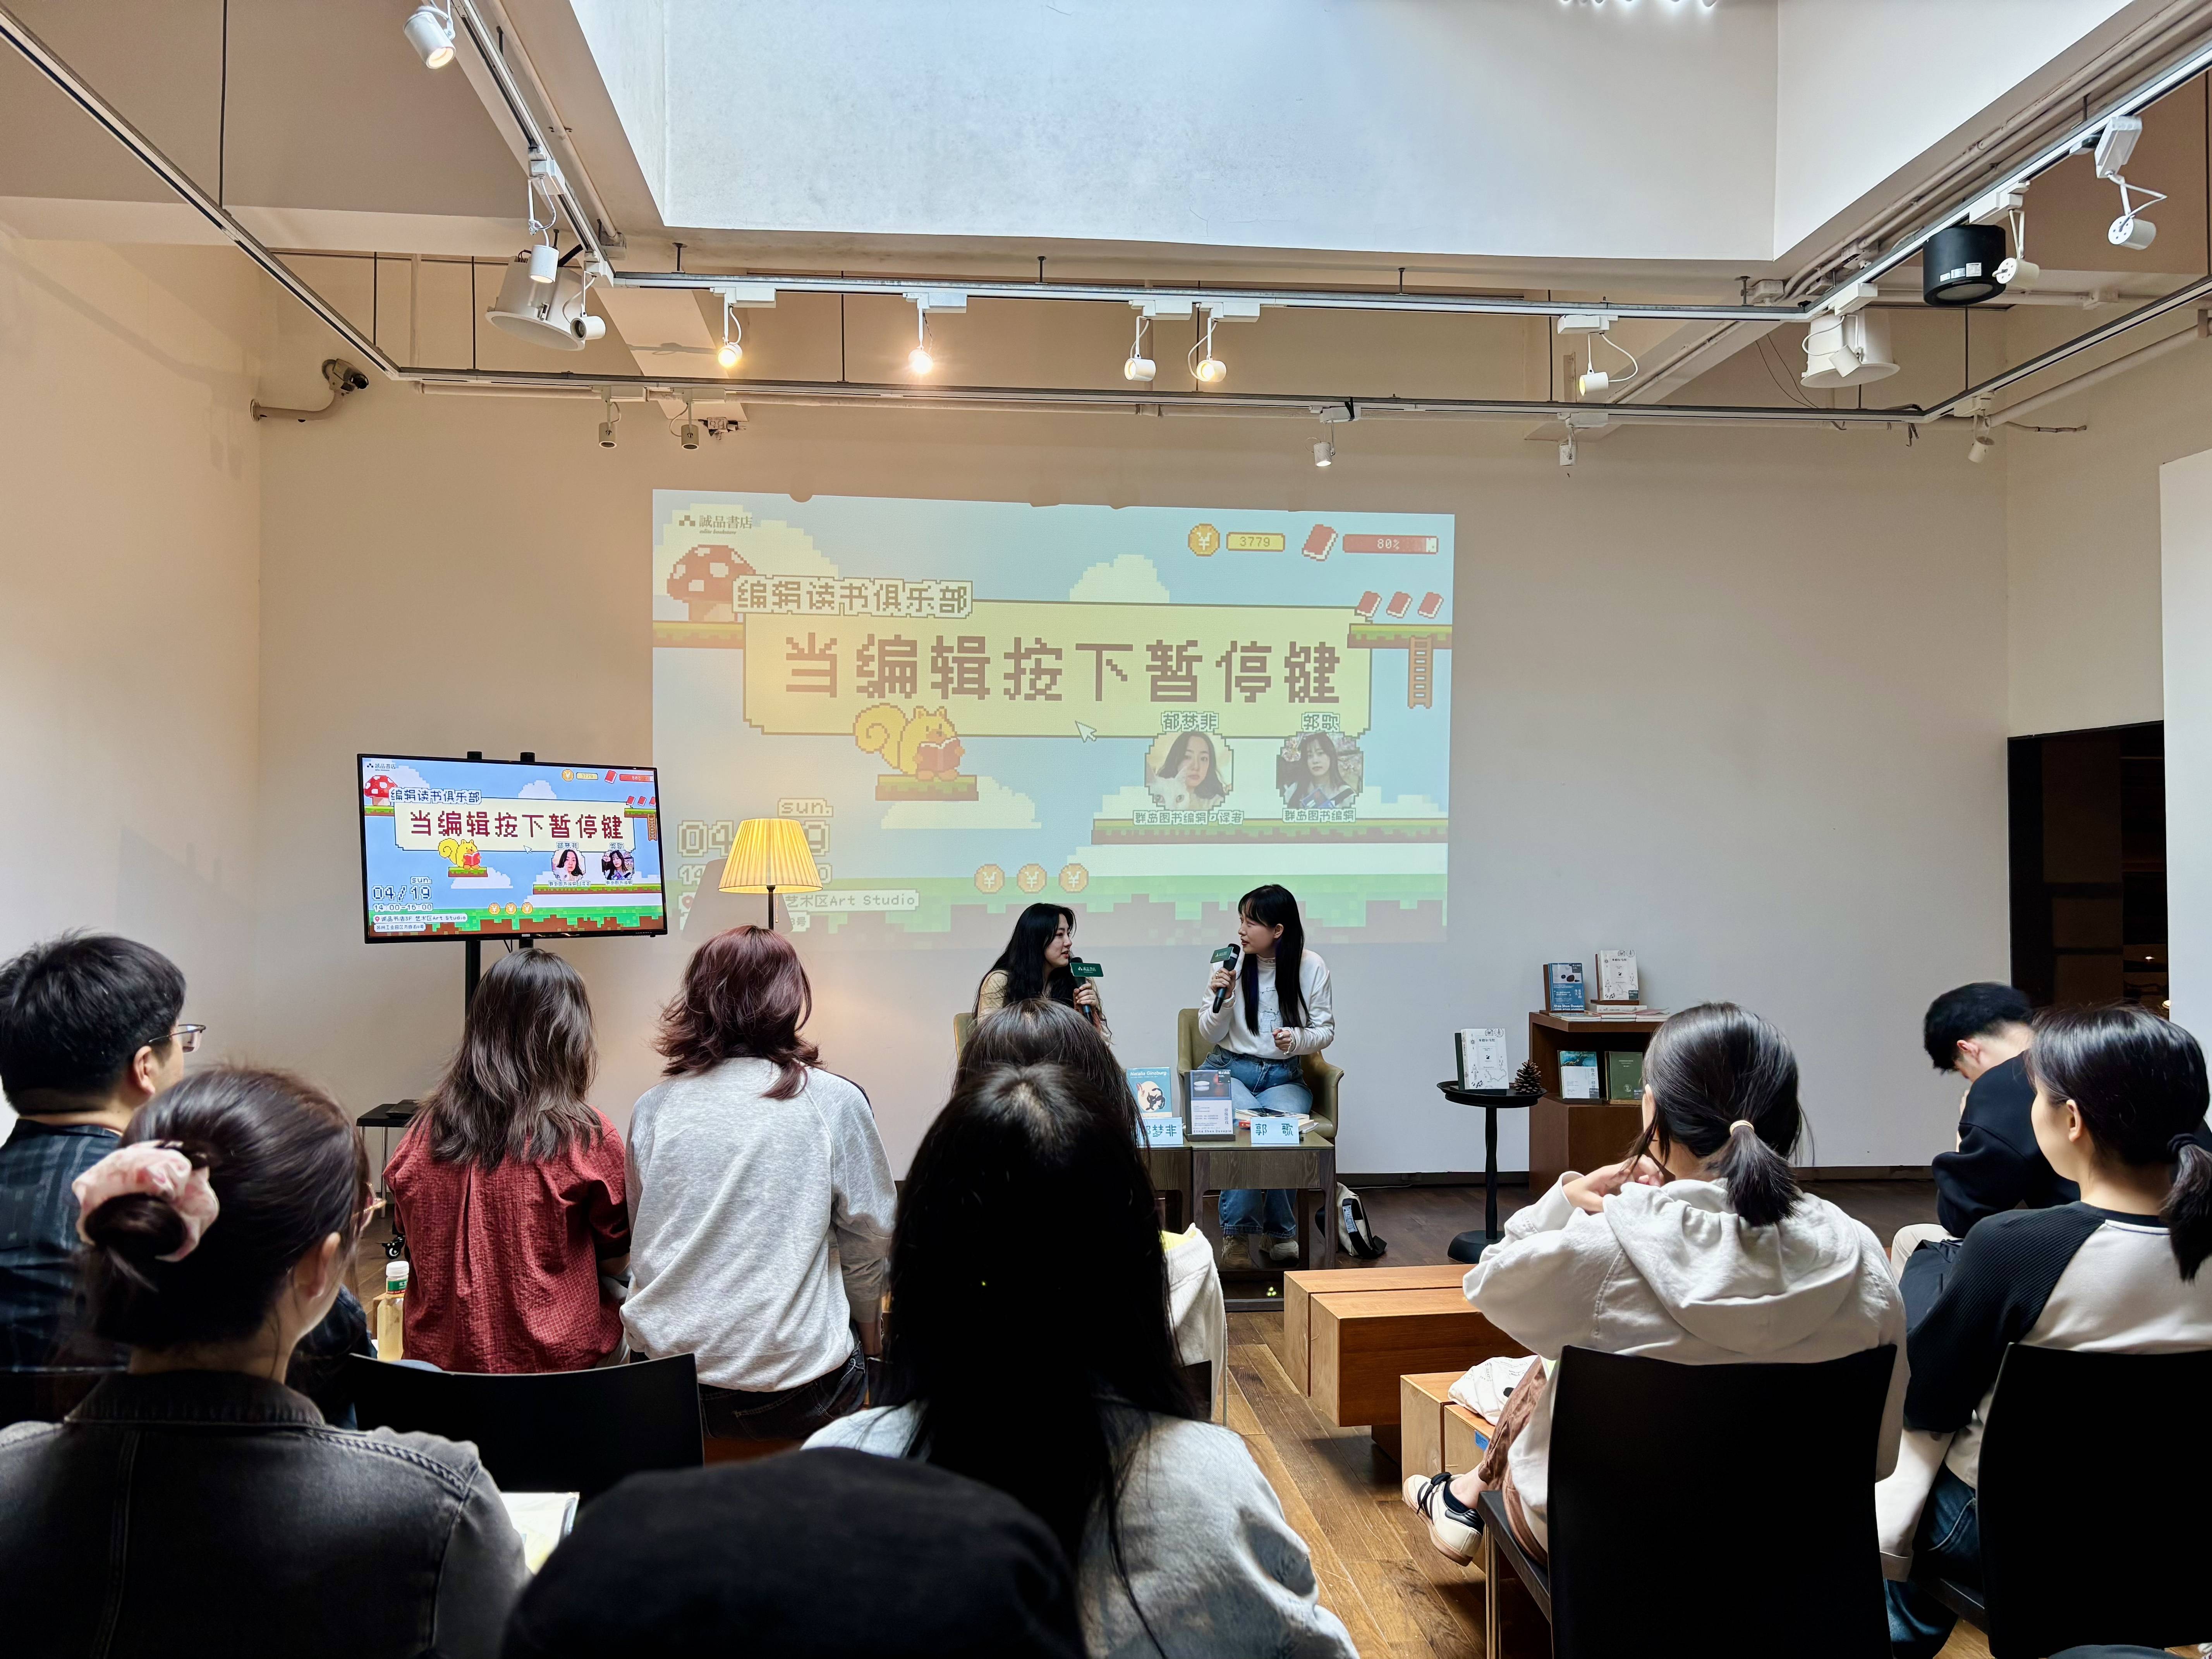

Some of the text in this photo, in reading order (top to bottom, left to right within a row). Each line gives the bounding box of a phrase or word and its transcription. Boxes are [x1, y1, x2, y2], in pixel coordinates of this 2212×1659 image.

[699, 515, 752, 529] 誠品書店
[1240, 536, 1270, 547] 3779
[1377, 539, 1400, 550] 80%
[737, 580, 967, 614] 编辑读书俱乐部
[785, 632, 1340, 703] 当编辑按下暂停键
[1304, 714, 1338, 730] 郭歌
[391, 789, 480, 803] 编辑读书俱乐部
[781, 802, 830, 814] sun.
[1285, 810, 1354, 821] 群岛图书编辑
[410, 810, 624, 840] 当编辑按下暂停键
[373, 886, 430, 901] 04/19
[863, 894, 915, 907] Studio
